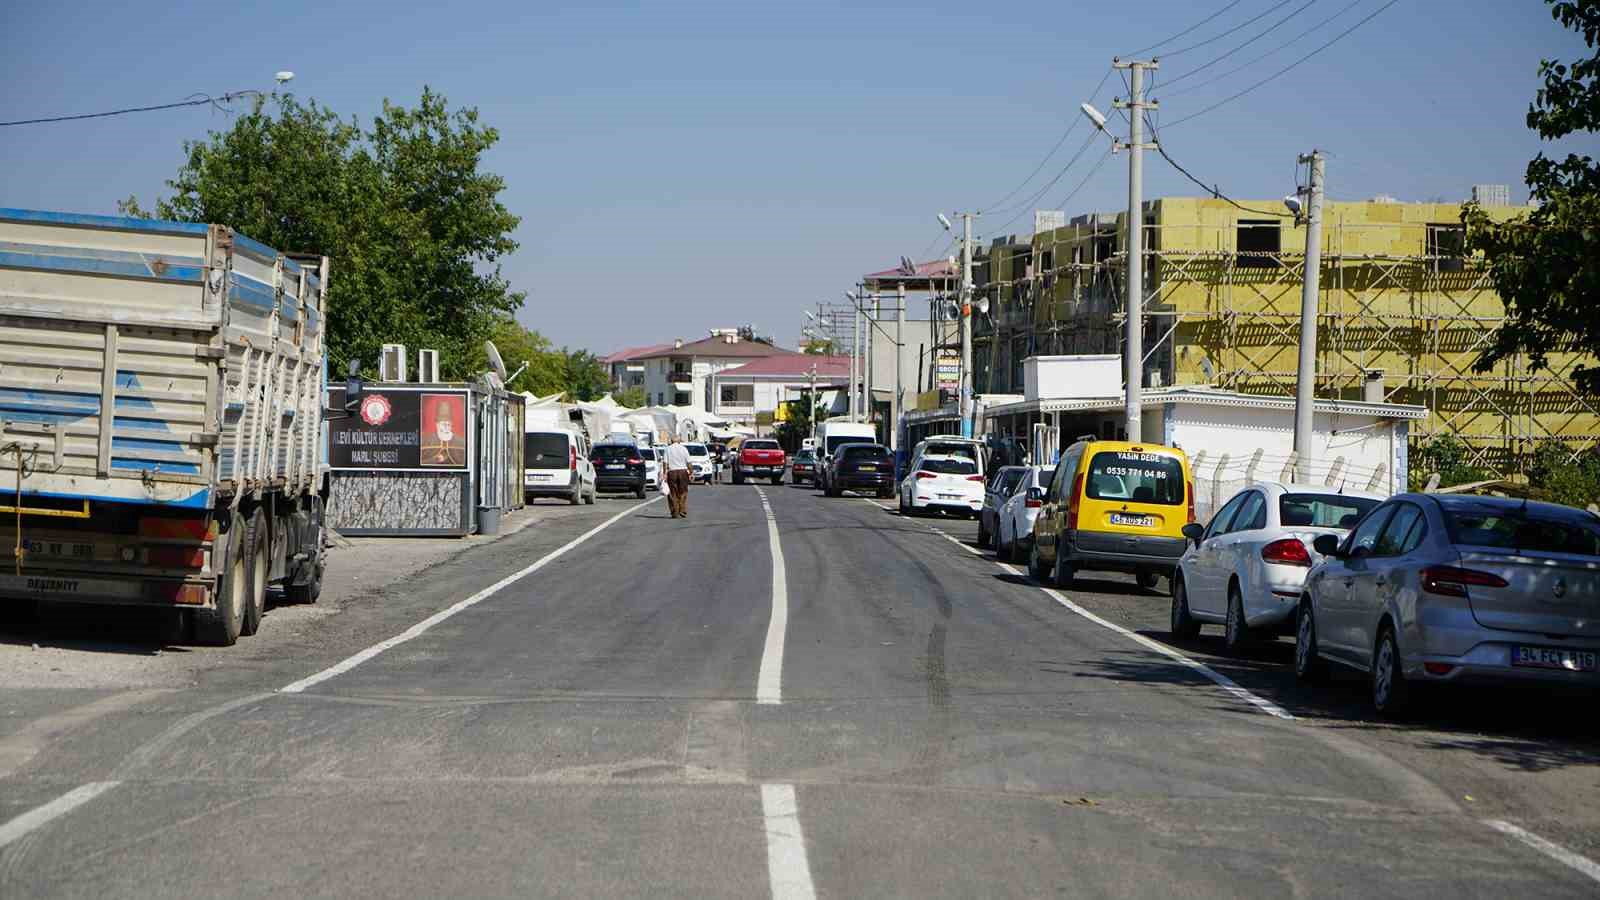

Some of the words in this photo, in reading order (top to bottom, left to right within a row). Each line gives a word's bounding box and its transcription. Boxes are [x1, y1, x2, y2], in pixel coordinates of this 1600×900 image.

[352, 429, 377, 446] KÜLTÜR
[1140, 454, 1161, 463] DEDE
[1106, 467, 1126, 476] 0535
[1144, 470, 1155, 478] 04
